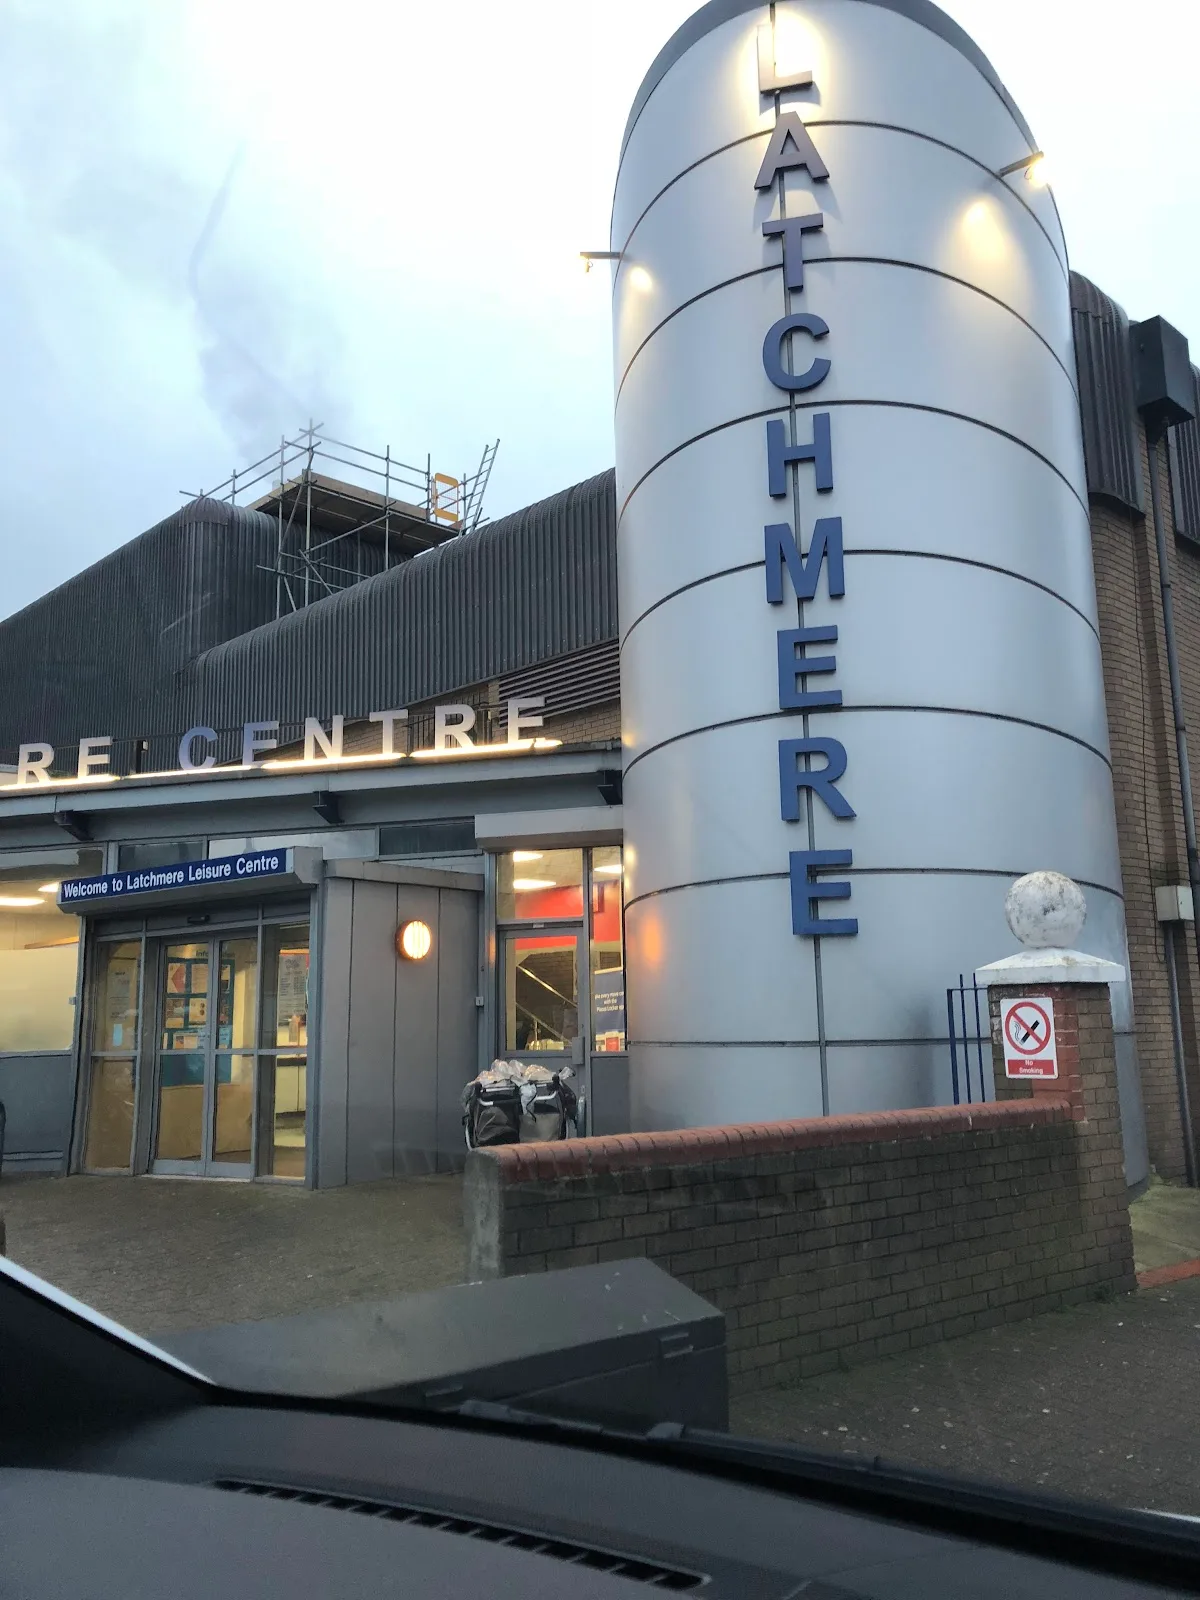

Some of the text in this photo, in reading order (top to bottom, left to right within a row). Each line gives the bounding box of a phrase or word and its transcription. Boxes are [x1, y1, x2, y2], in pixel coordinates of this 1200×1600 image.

[755, 24, 858, 936] LATCHMERE
[178, 697, 546, 772] CENTRE
[64, 855, 279, 898] Welcome to Latchmere Leisure Centre
